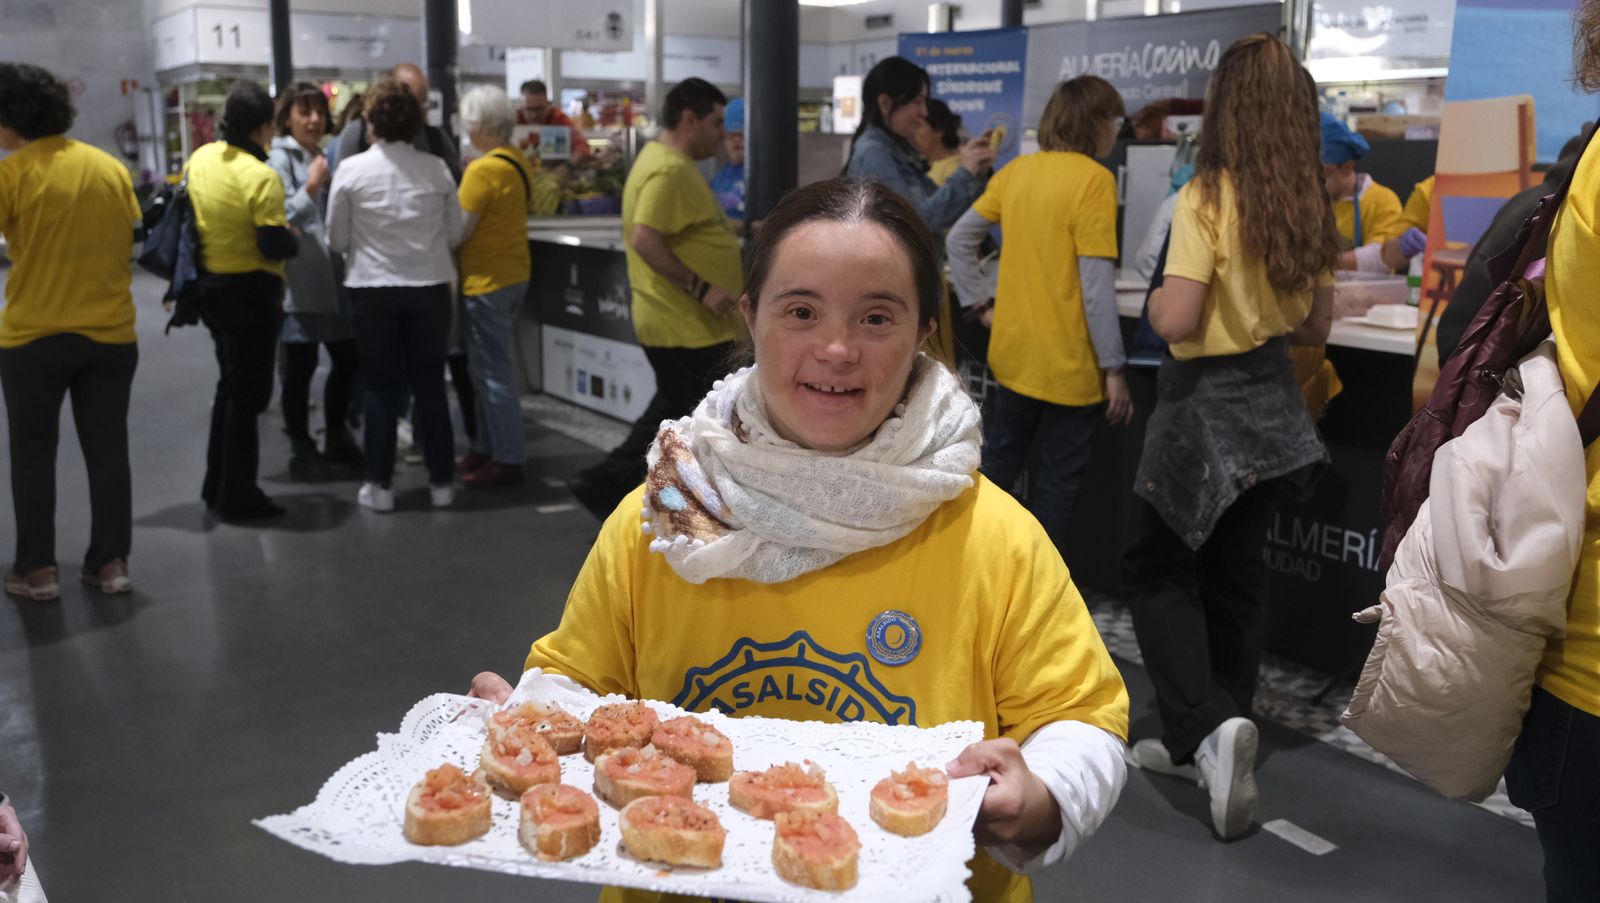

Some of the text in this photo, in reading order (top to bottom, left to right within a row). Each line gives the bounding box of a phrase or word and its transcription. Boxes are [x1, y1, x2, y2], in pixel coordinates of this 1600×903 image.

[211, 23, 241, 49] 11
[925, 60, 1021, 76] INTERNACIONAL
[936, 77, 1003, 95] SÍNDROME
[1266, 511, 1380, 572] LMERÍ
[1262, 546, 1322, 582] IUDAD
[711, 673, 882, 725] ASALSID
